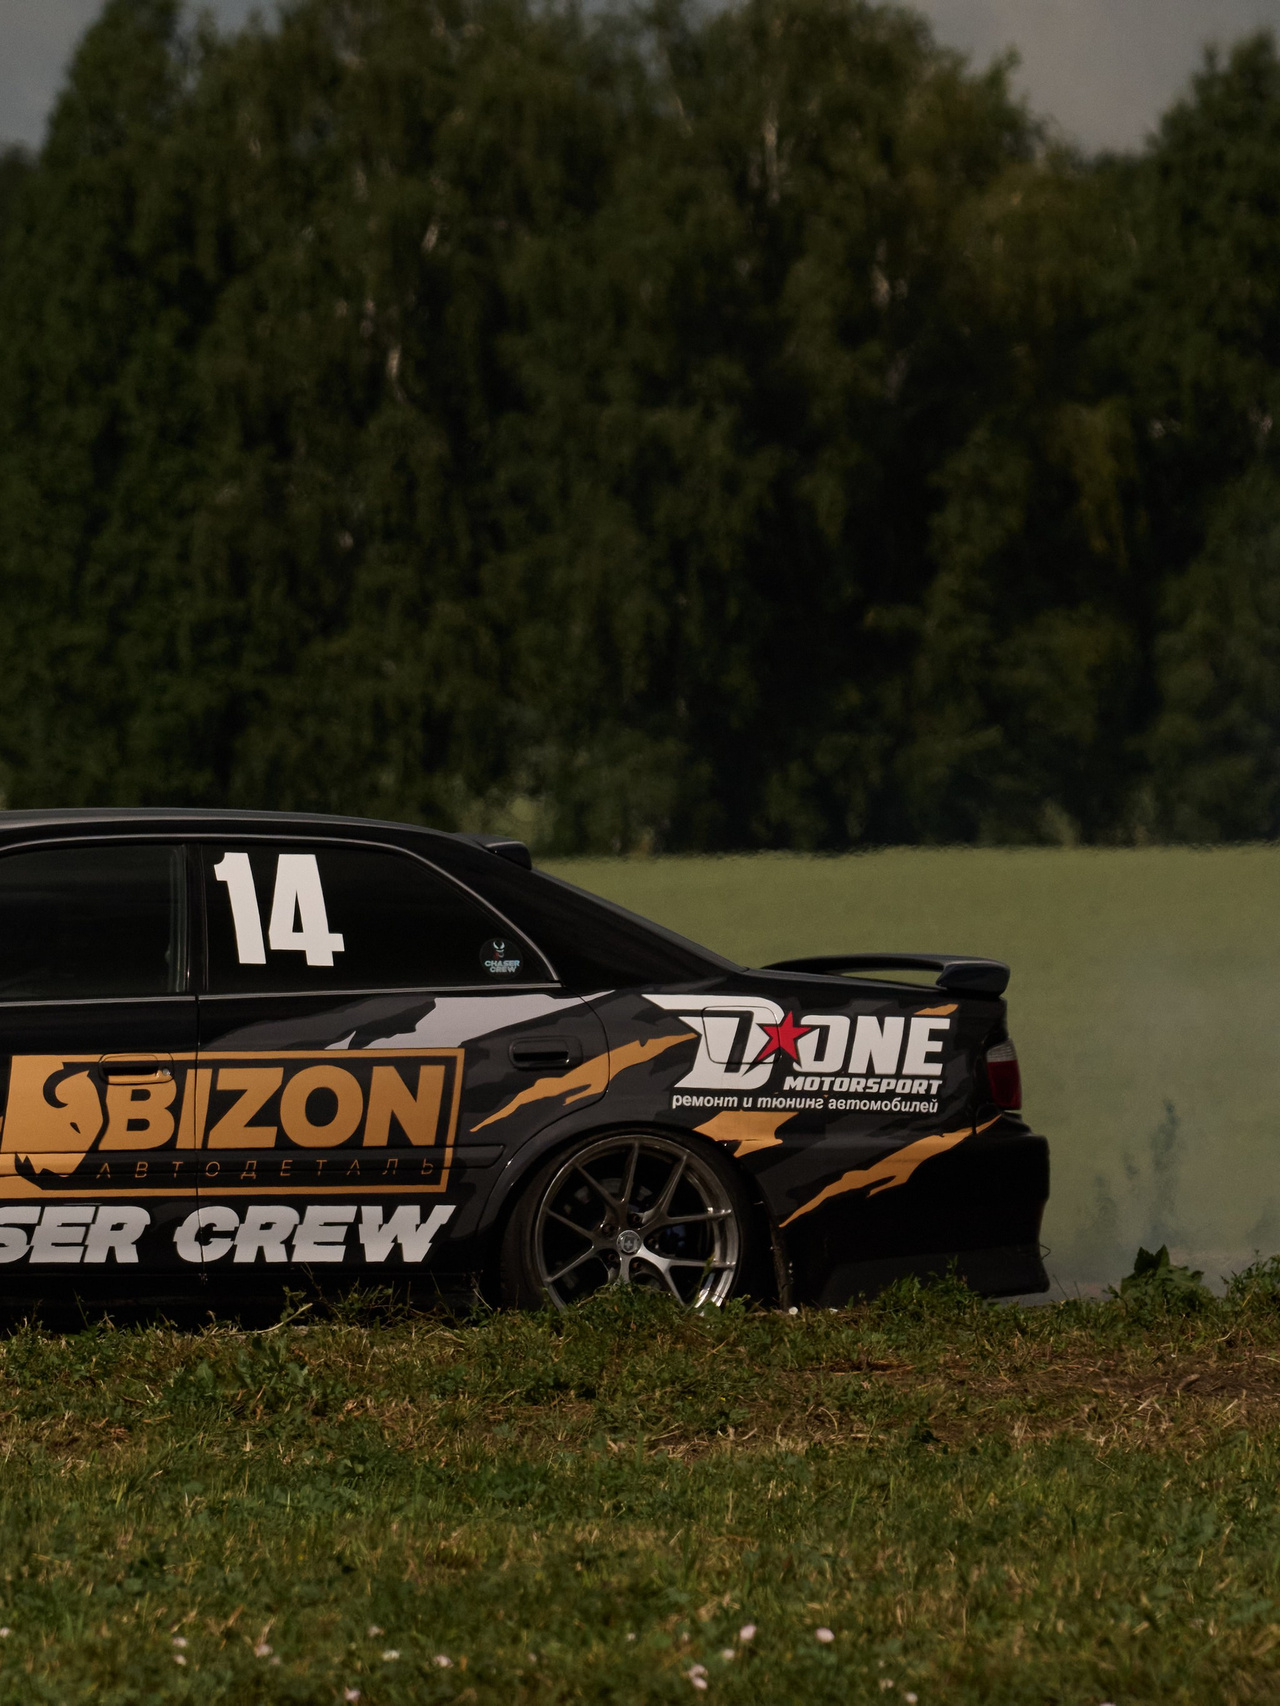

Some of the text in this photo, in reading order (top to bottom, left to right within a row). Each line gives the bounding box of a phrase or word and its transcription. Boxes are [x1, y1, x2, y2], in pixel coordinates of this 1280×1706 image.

[214, 852, 345, 966] 14
[672, 1093, 939, 1114] ремонт и тюнинг автомобилей
[783, 1076, 943, 1095] MOTORSPORT
[97, 1064, 446, 1151] BIZON
[95, 1158, 436, 1180] АВТОДЕТАЛЬ
[173, 1204, 457, 1263] CREW
